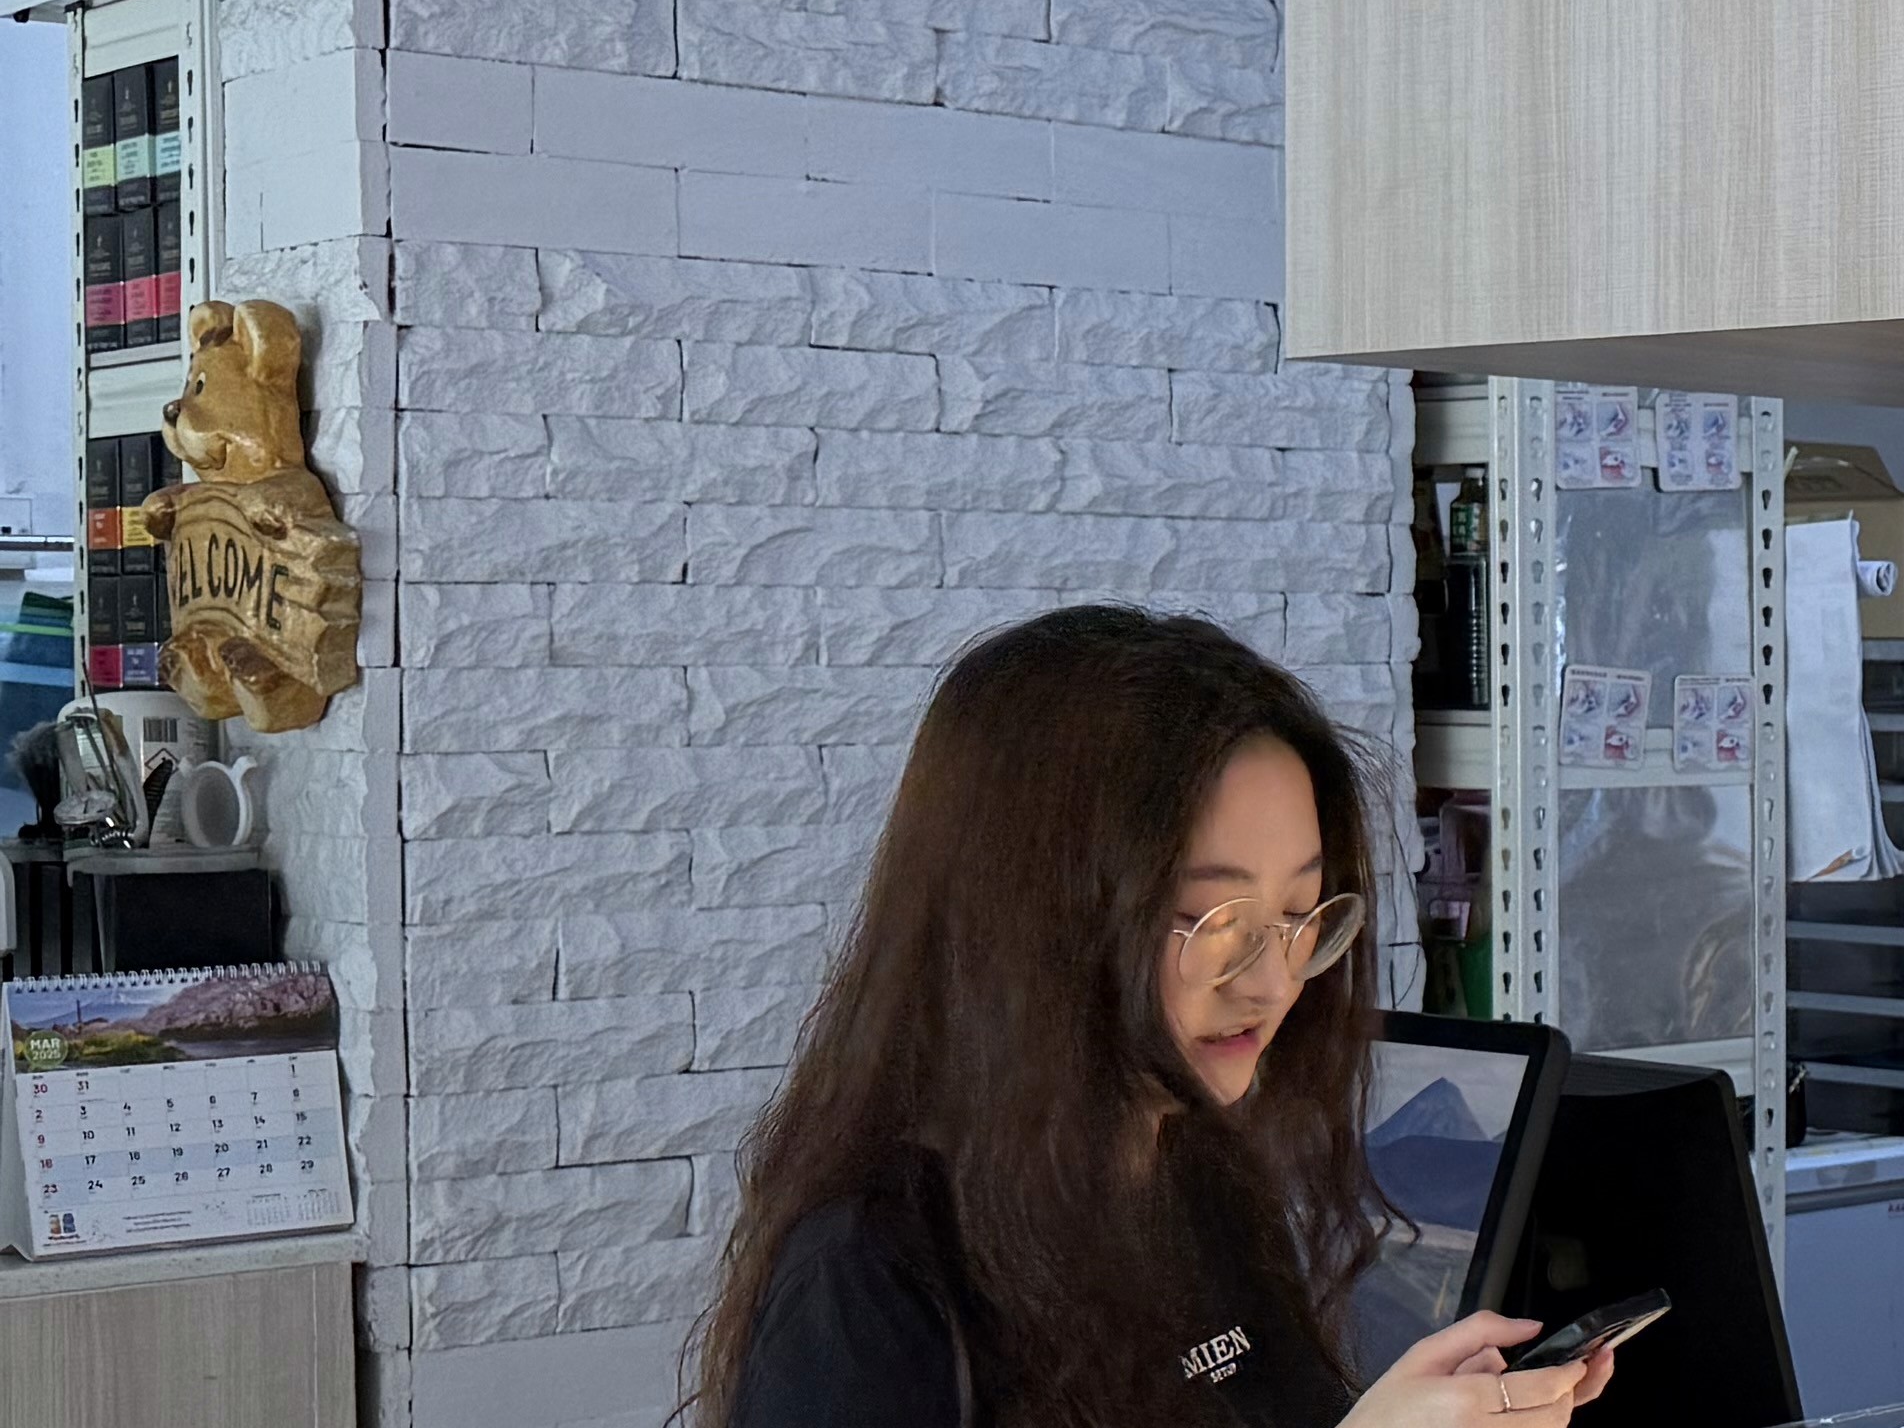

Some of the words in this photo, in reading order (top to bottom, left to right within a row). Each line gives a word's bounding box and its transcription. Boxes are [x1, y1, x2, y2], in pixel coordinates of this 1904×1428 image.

[173, 533, 289, 631] ELCOME
[30, 1039, 60, 1050] MAR
[77, 1081, 89, 1091] 31
[291, 1064, 295, 1075] 1
[123, 1102, 131, 1112] 4
[251, 1091, 258, 1102] 7
[82, 1130, 94, 1140] 10
[126, 1127, 135, 1136] 11
[170, 1123, 181, 1132] 12
[212, 1119, 223, 1129] 13
[254, 1116, 265, 1125] 14
[85, 1155, 96, 1165] 17
[172, 1147, 183, 1157] 19
[215, 1143, 229, 1154] 20
[256, 1140, 268, 1150] 21
[299, 1135, 311, 1146] 22
[88, 1180, 103, 1190] 24
[217, 1167, 230, 1178] 27
[301, 1160, 314, 1170] 29
[1178, 1326, 1250, 1378] MIEN
